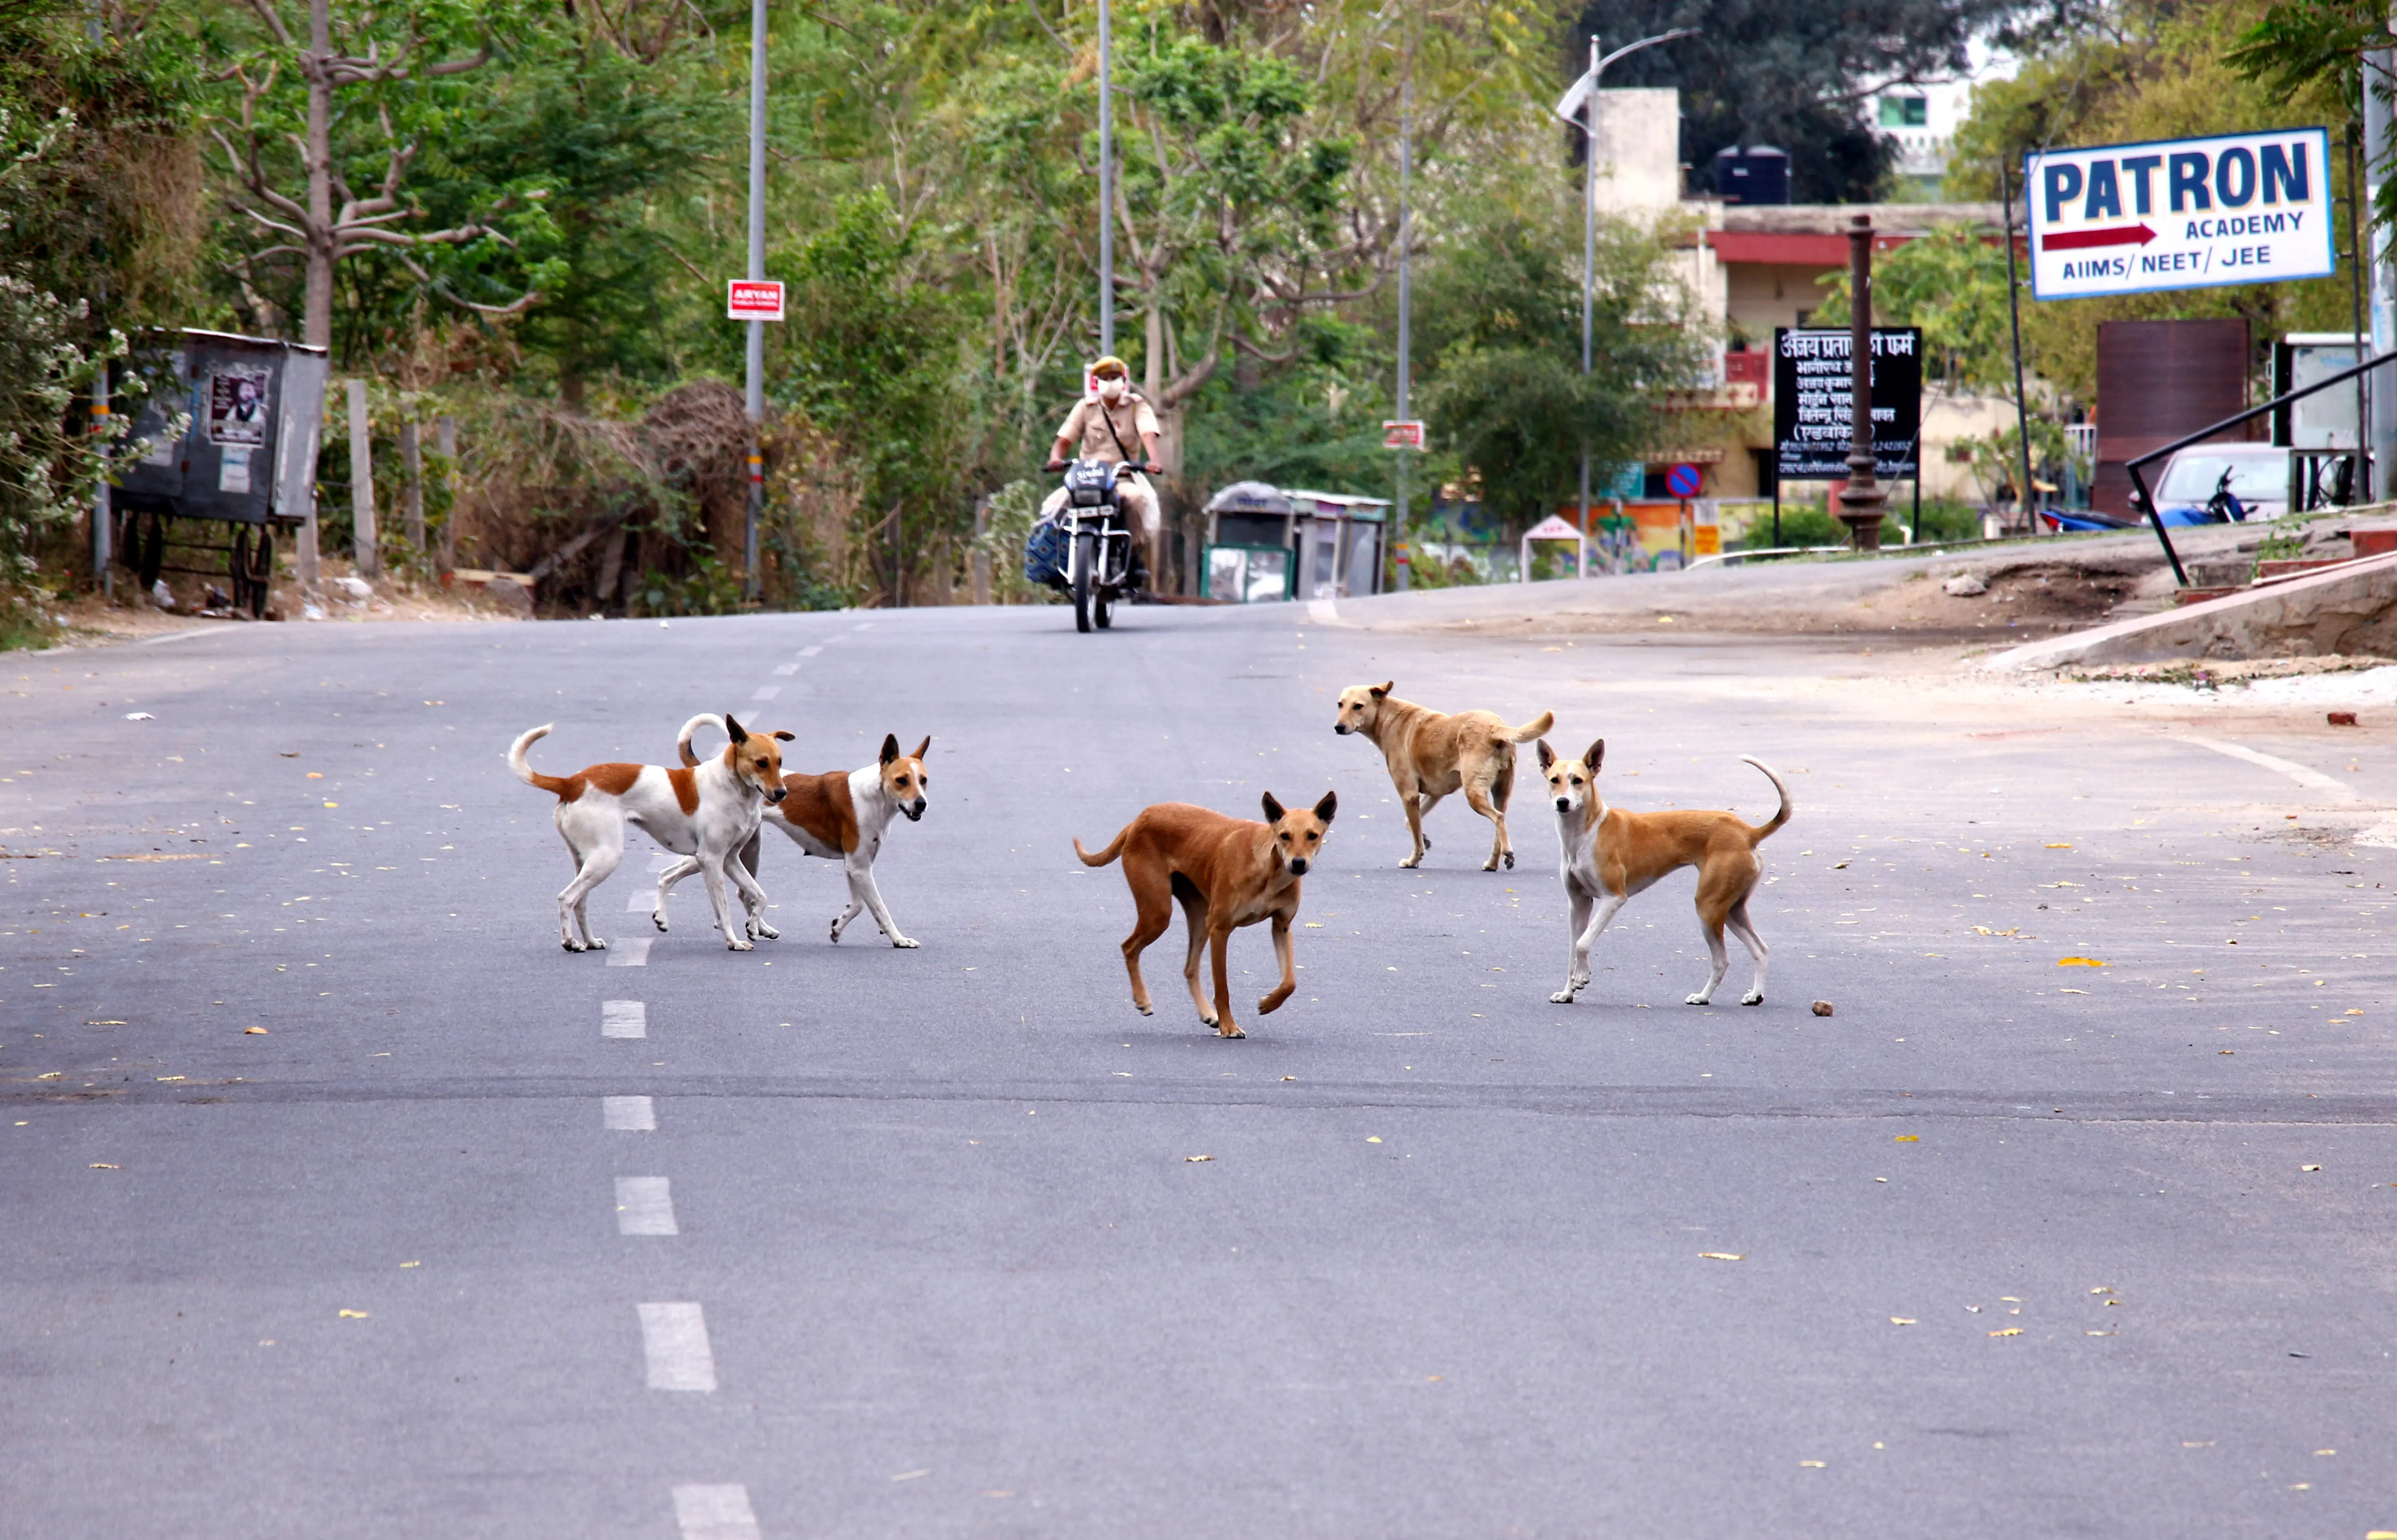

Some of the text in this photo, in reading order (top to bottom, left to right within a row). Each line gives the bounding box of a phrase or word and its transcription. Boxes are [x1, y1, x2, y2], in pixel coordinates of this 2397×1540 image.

[2044, 142, 2312, 224] PATRON
[2186, 212, 2305, 241] ACADEMY
[2222, 246, 2271, 266] JEE
[734, 289, 778, 300] ARYAN
